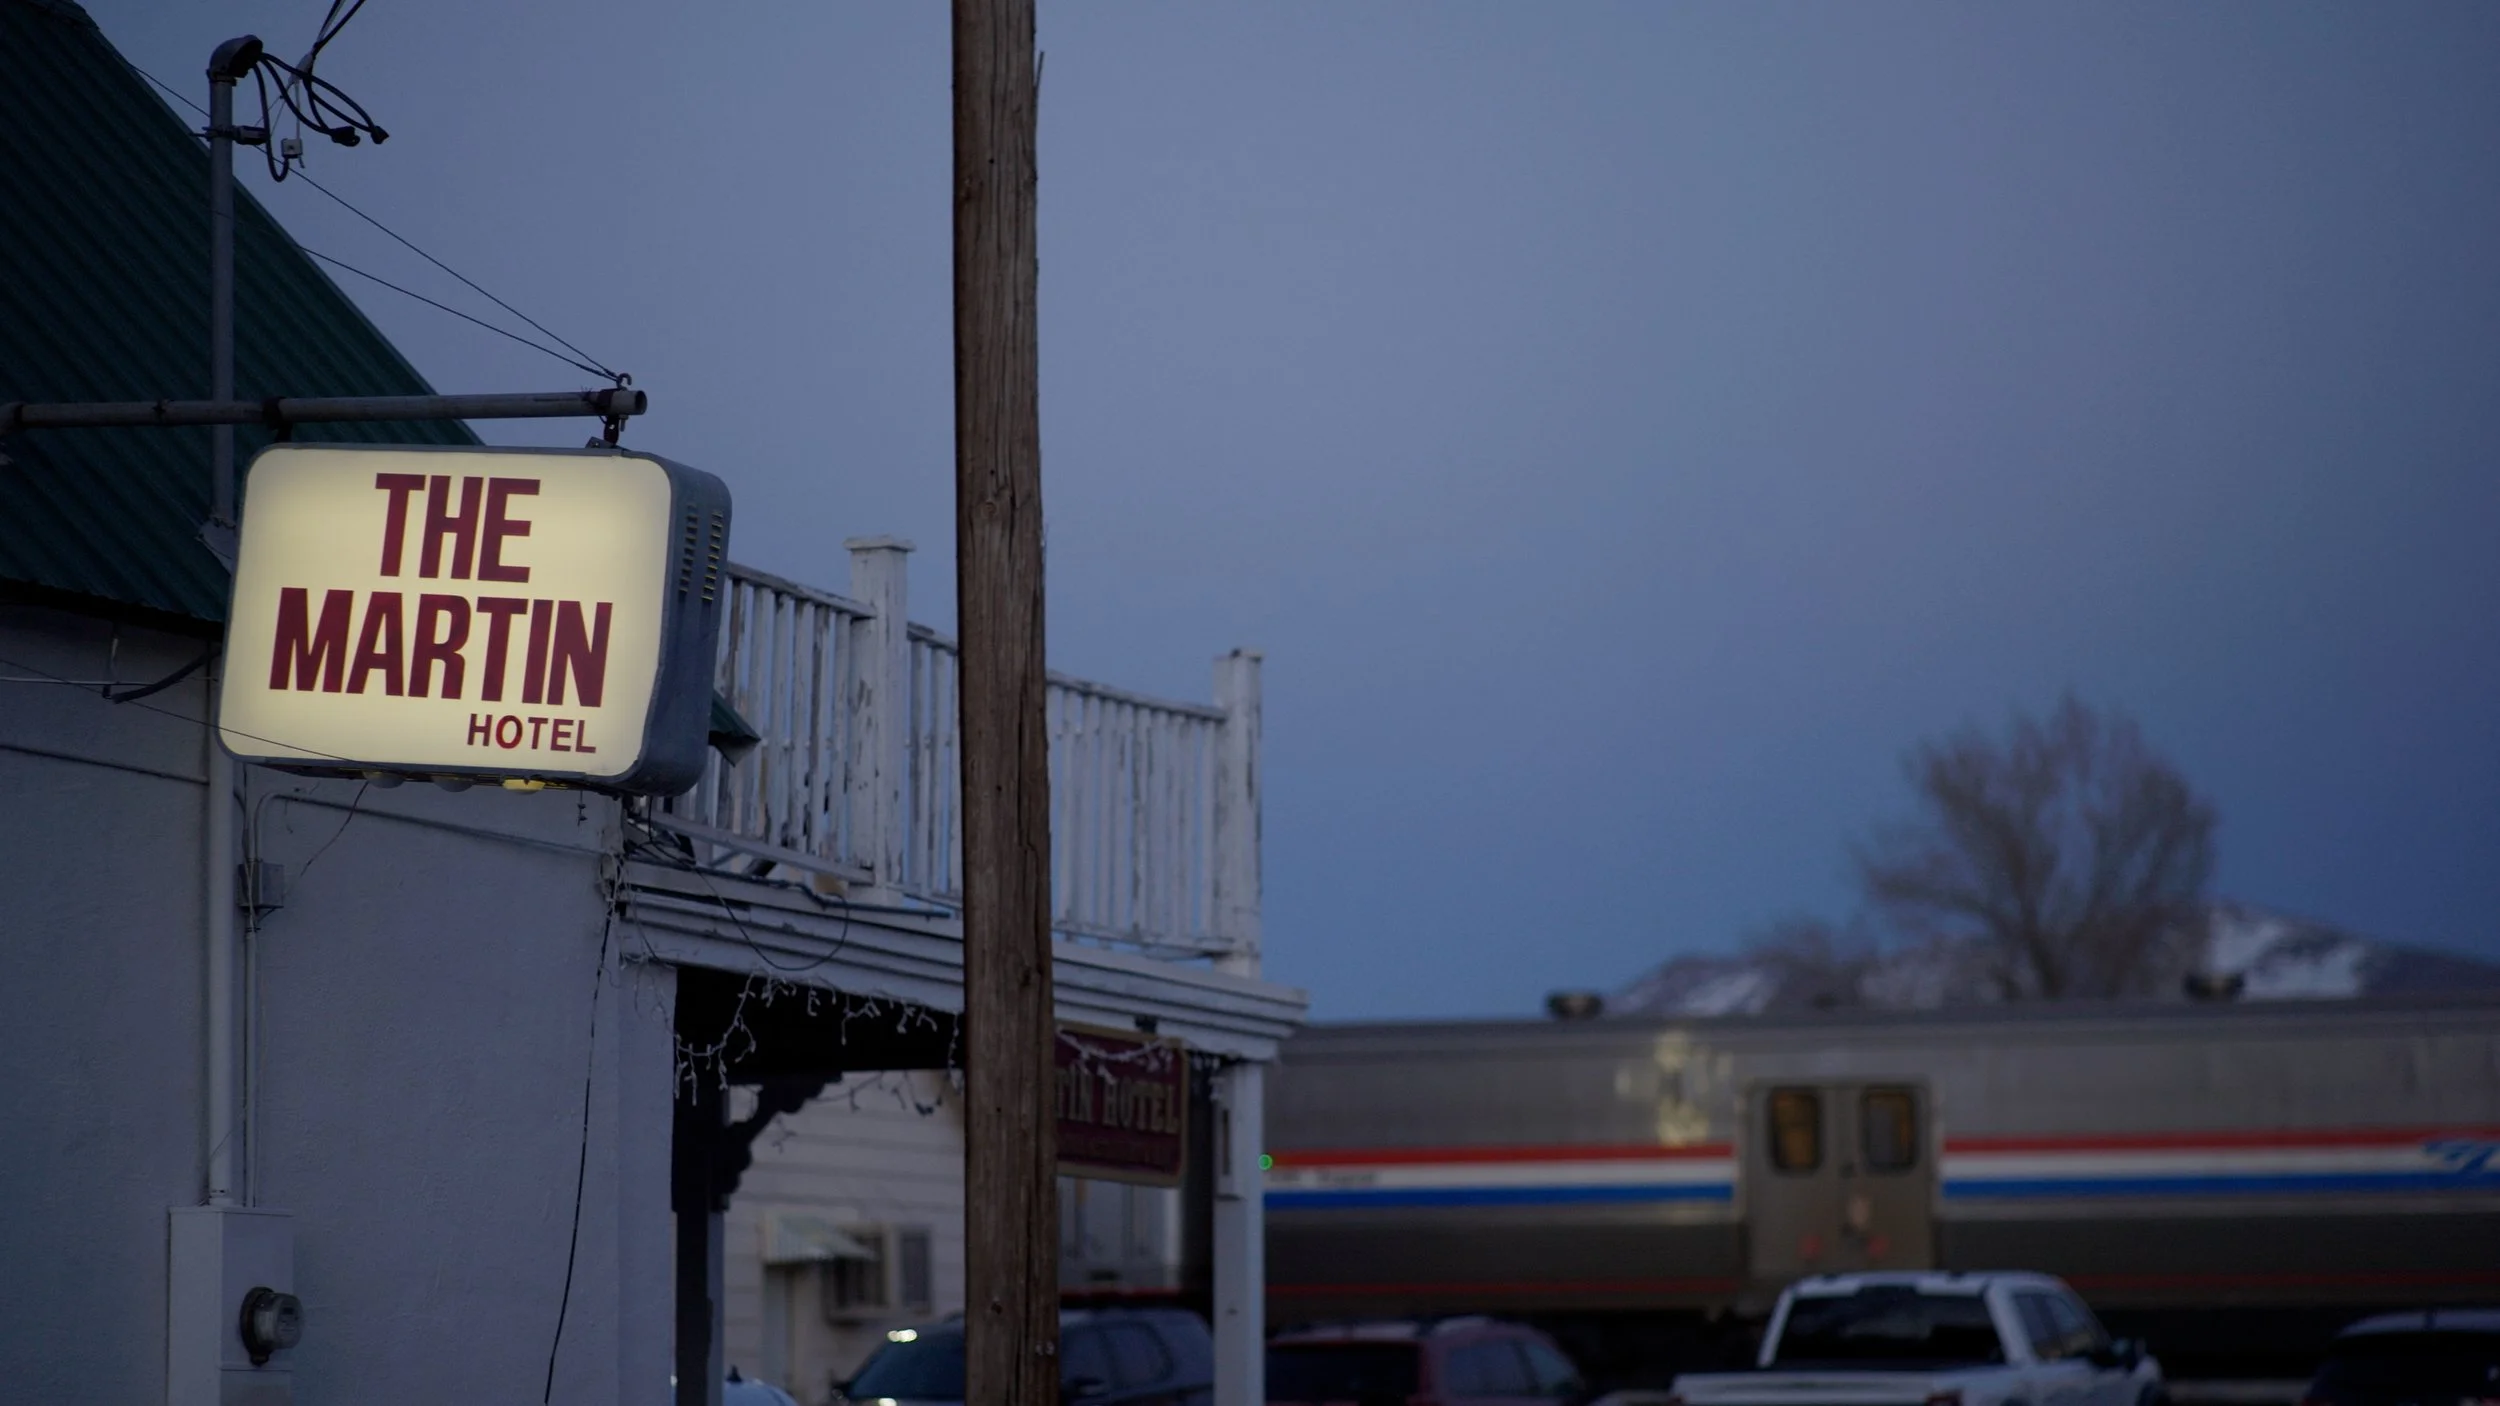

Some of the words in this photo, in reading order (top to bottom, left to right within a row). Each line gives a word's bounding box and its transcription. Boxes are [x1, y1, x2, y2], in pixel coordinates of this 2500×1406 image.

[375, 472, 541, 583] THE
[269, 586, 613, 708] MARTIN
[466, 713, 598, 754] HOTEL
[1102, 1076, 1180, 1135] HOTEL
